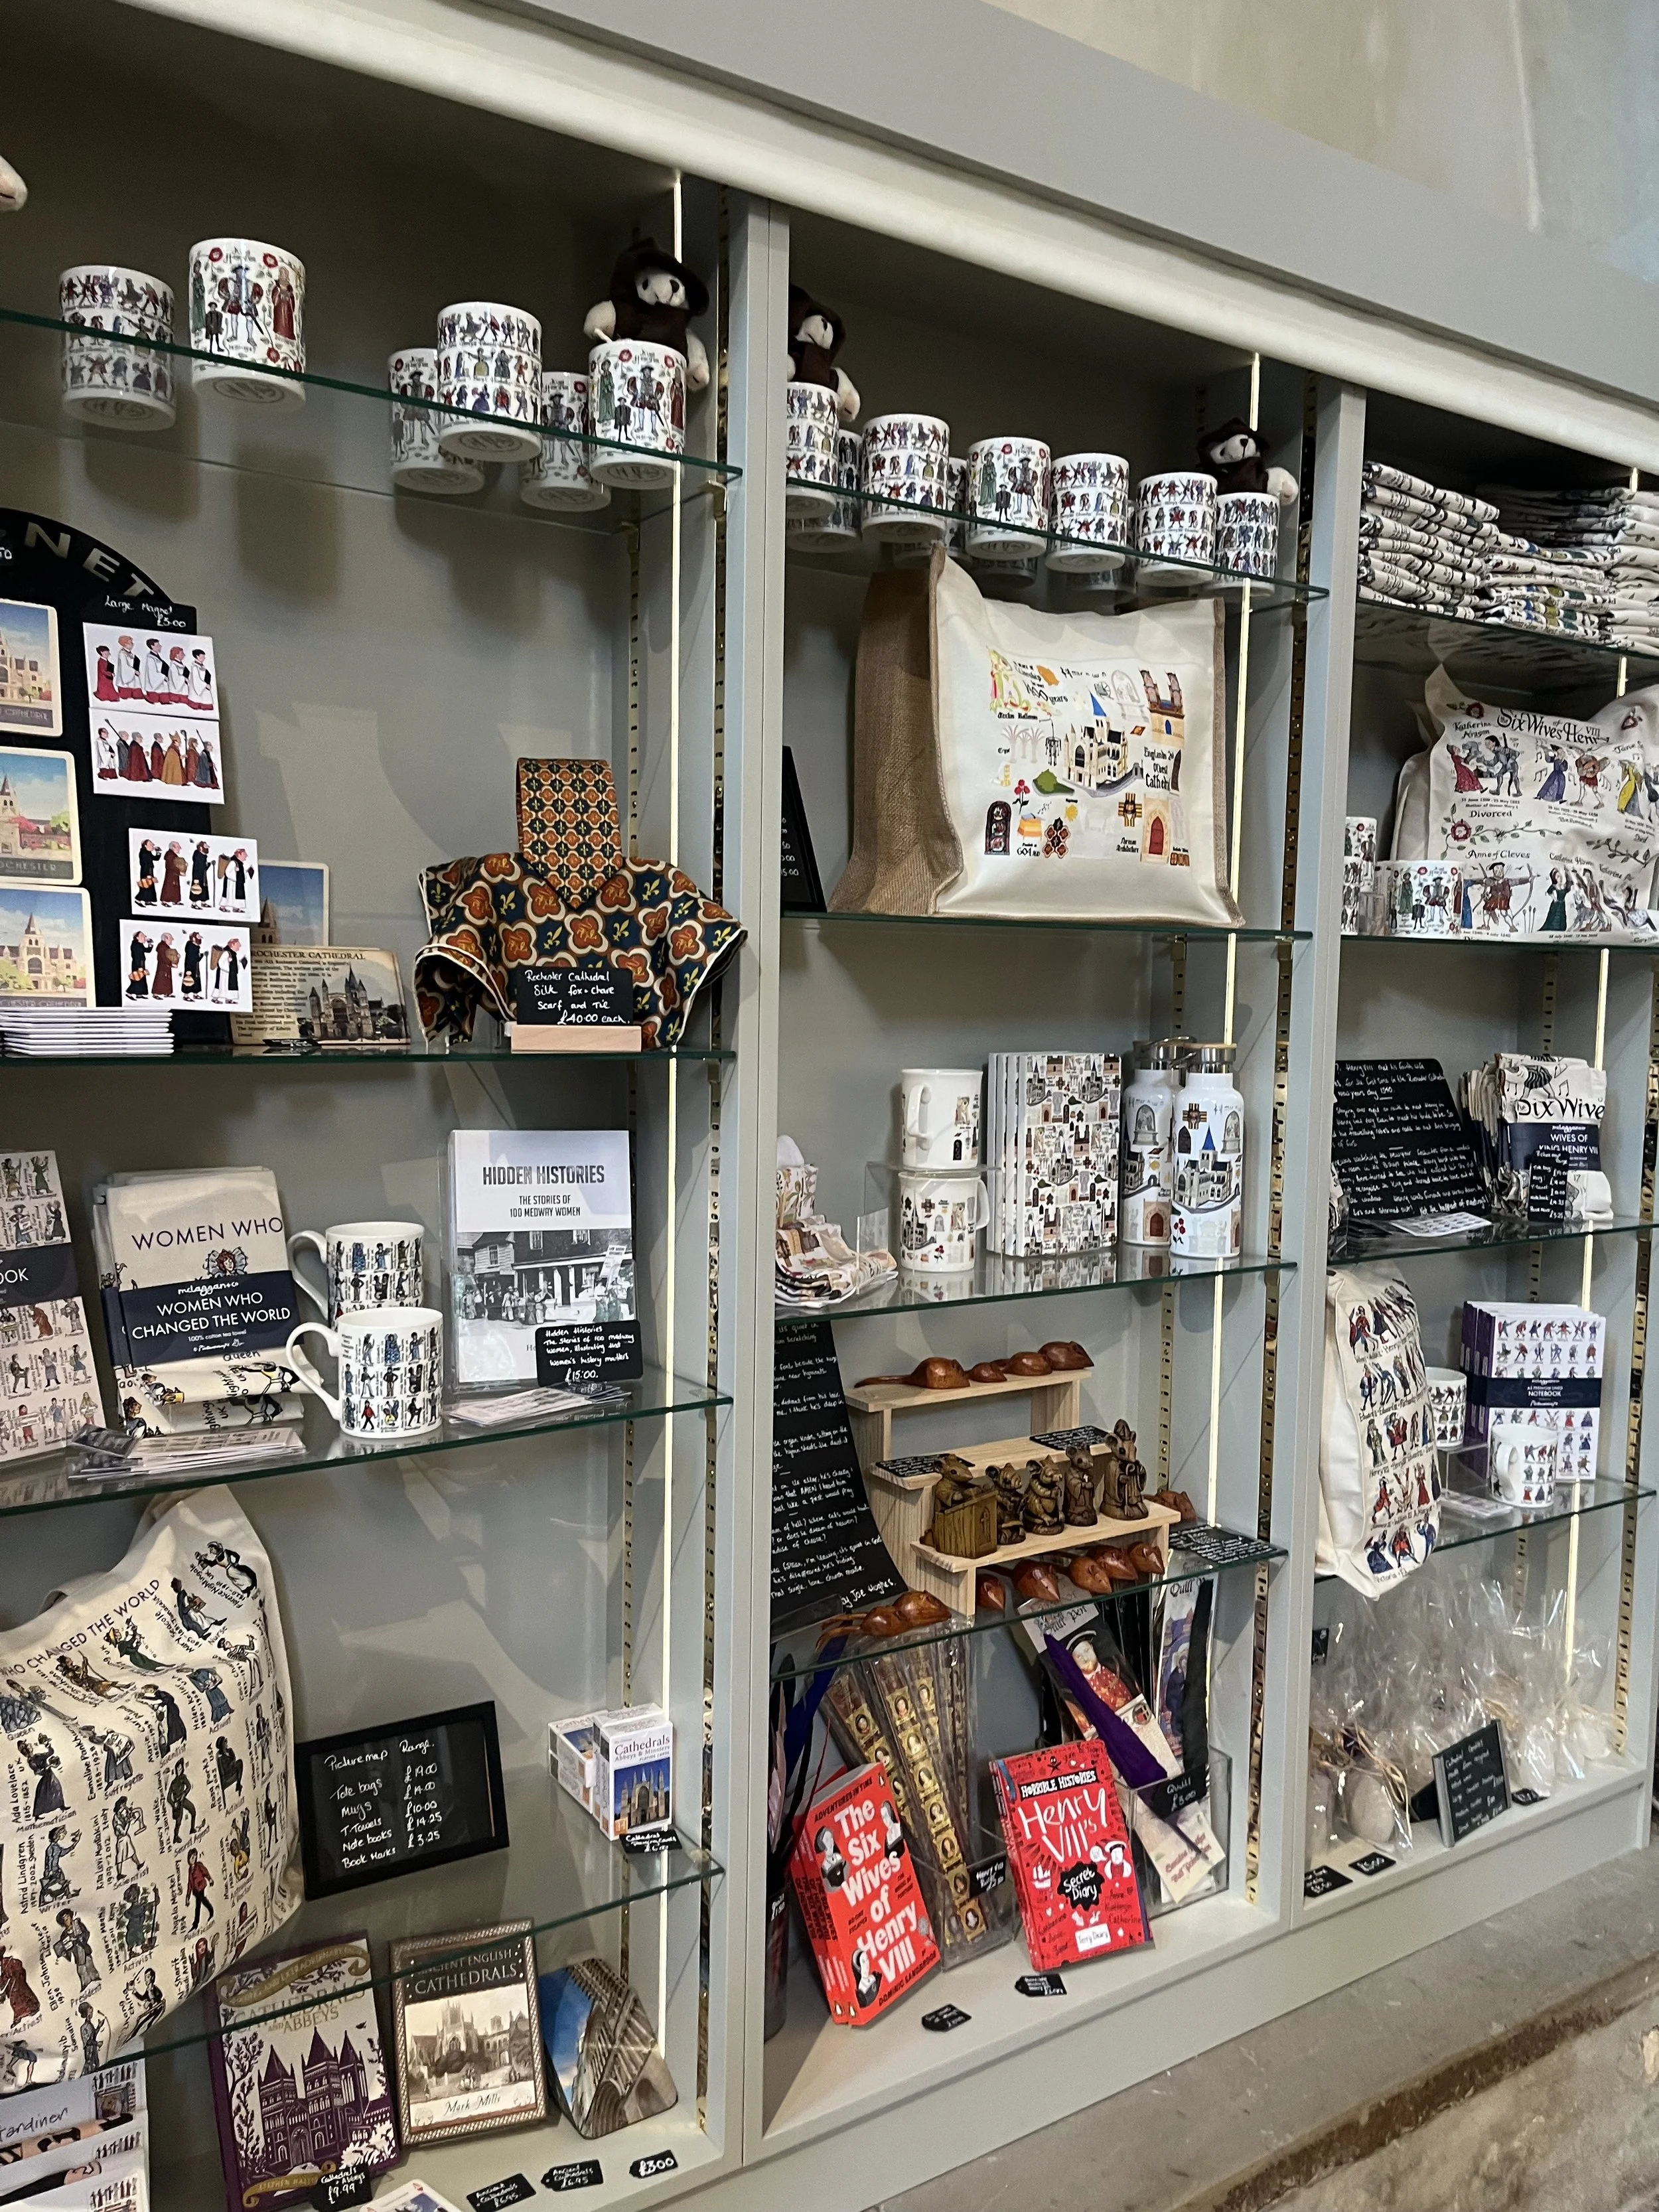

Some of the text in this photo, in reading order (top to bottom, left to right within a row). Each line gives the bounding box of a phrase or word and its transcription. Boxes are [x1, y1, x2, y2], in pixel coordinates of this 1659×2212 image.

[1526, 713, 1563, 741] Wives
[1470, 810, 1513, 818] Divorced
[309, 952, 367, 960] CATHEDRAL
[568, 970, 610, 982] Cathedral
[534, 984, 558, 996] Silk
[570, 1000, 587, 1009] and
[1550, 1134, 1576, 1142] WIVES
[1561, 1145, 1588, 1154] HENRY
[482, 1165, 605, 1185] HIDDEN HISTORIES
[519, 1194, 571, 1205] THE STORIES OF
[510, 1207, 581, 1218] 100 MEDWAY WOMEN
[131, 1217, 284, 1251] WOMEN WHO
[0, 1267, 29, 1285] OK
[156, 1291, 263, 1317] WOMEN WHO
[131, 1307, 291, 1339] CHANGED THE WORLD
[113, 1578, 160, 1618] WORLD
[86, 1613, 115, 1637] THE
[26, 1631, 88, 1669] CHANGED
[614, 1733, 670, 1756] Cathedrals
[7, 1763, 19, 1805] Lovelace
[358, 1778, 383, 1797] bags
[1057, 1770, 1097, 1789] HISTORIES
[11, 1804, 23, 1824] Ada
[341, 1801, 372, 1821] Mugs
[833, 1799, 875, 1839] The
[1017, 1787, 1108, 1840] Henry
[847, 1828, 882, 1866] Six
[17, 1841, 27, 1885] Lindgren
[841, 1850, 901, 1907] Wives
[1063, 1867, 1096, 1893] Secret
[20, 1886, 30, 1915] Astrid
[870, 1883, 890, 1923] of
[1072, 1884, 1098, 1901] Diary
[856, 1900, 918, 1958] Henry
[468, 1948, 512, 1966] ENGLISH
[877, 1934, 916, 1984] VIII
[414, 1962, 517, 1994] CATHEDRALS
[283, 2005, 340, 2033] ABBEYS
[445, 2093, 501, 2116] Mark Mills
